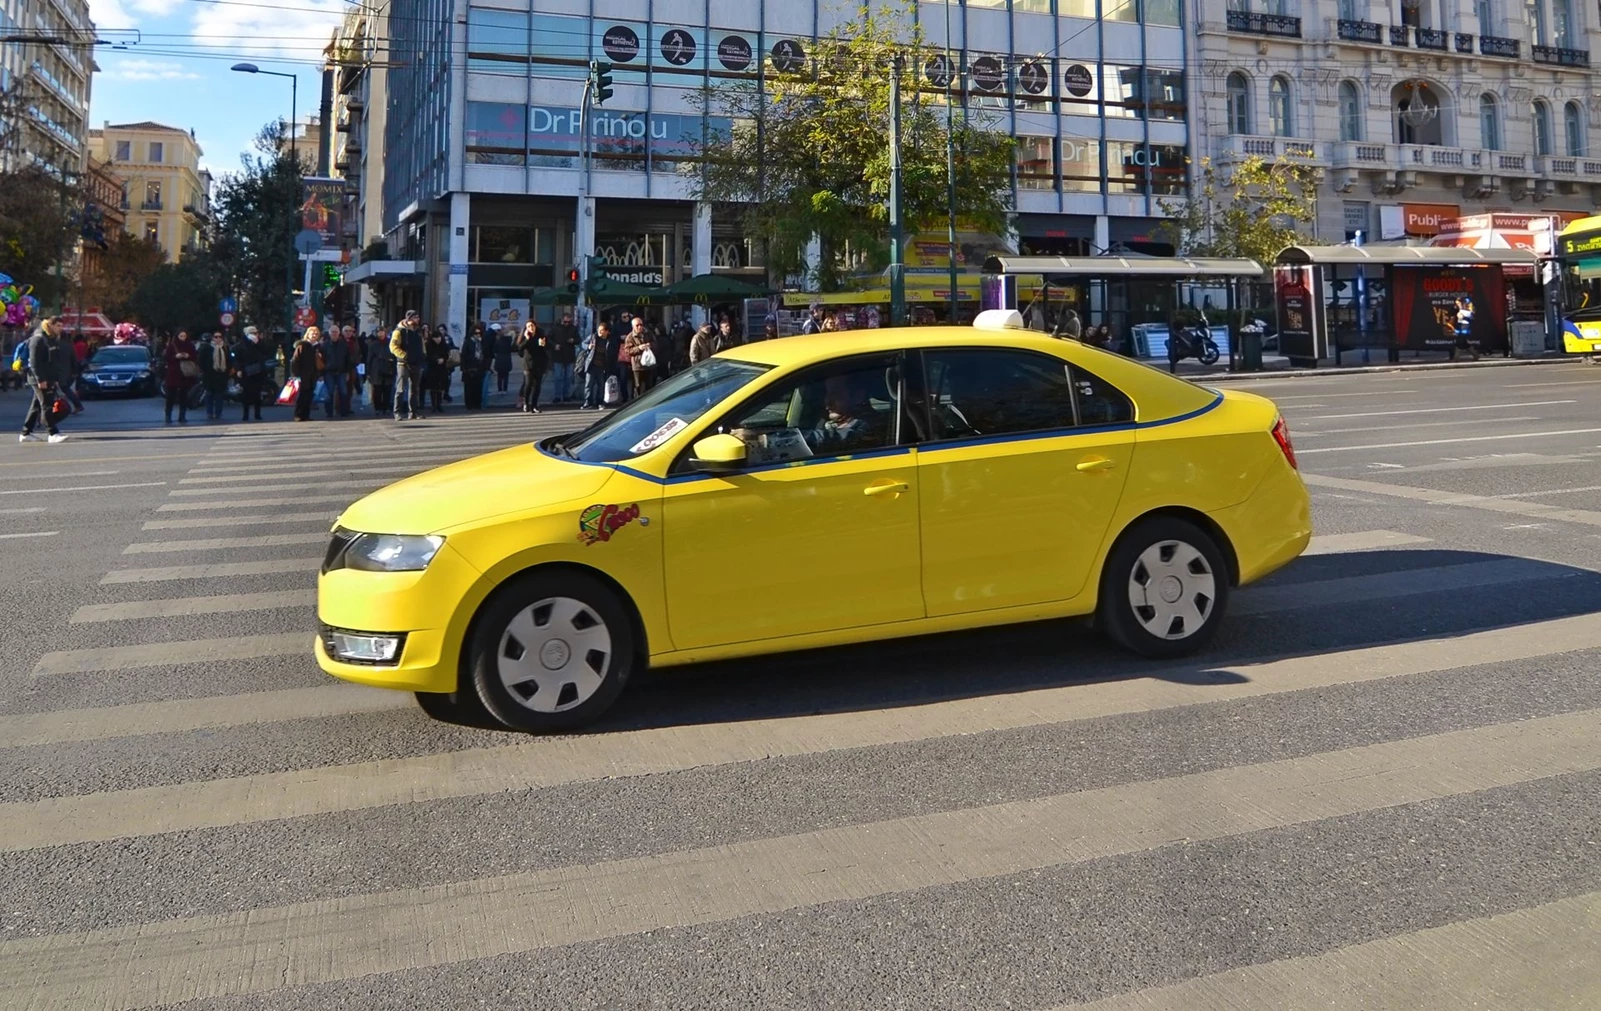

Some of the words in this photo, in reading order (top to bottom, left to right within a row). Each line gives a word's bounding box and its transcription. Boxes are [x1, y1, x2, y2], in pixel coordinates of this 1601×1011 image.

[530, 108, 565, 133] Dr
[1061, 140, 1084, 162] Dr
[305, 184, 342, 193] MOMIX
[1567, 240, 1574, 253] 5
